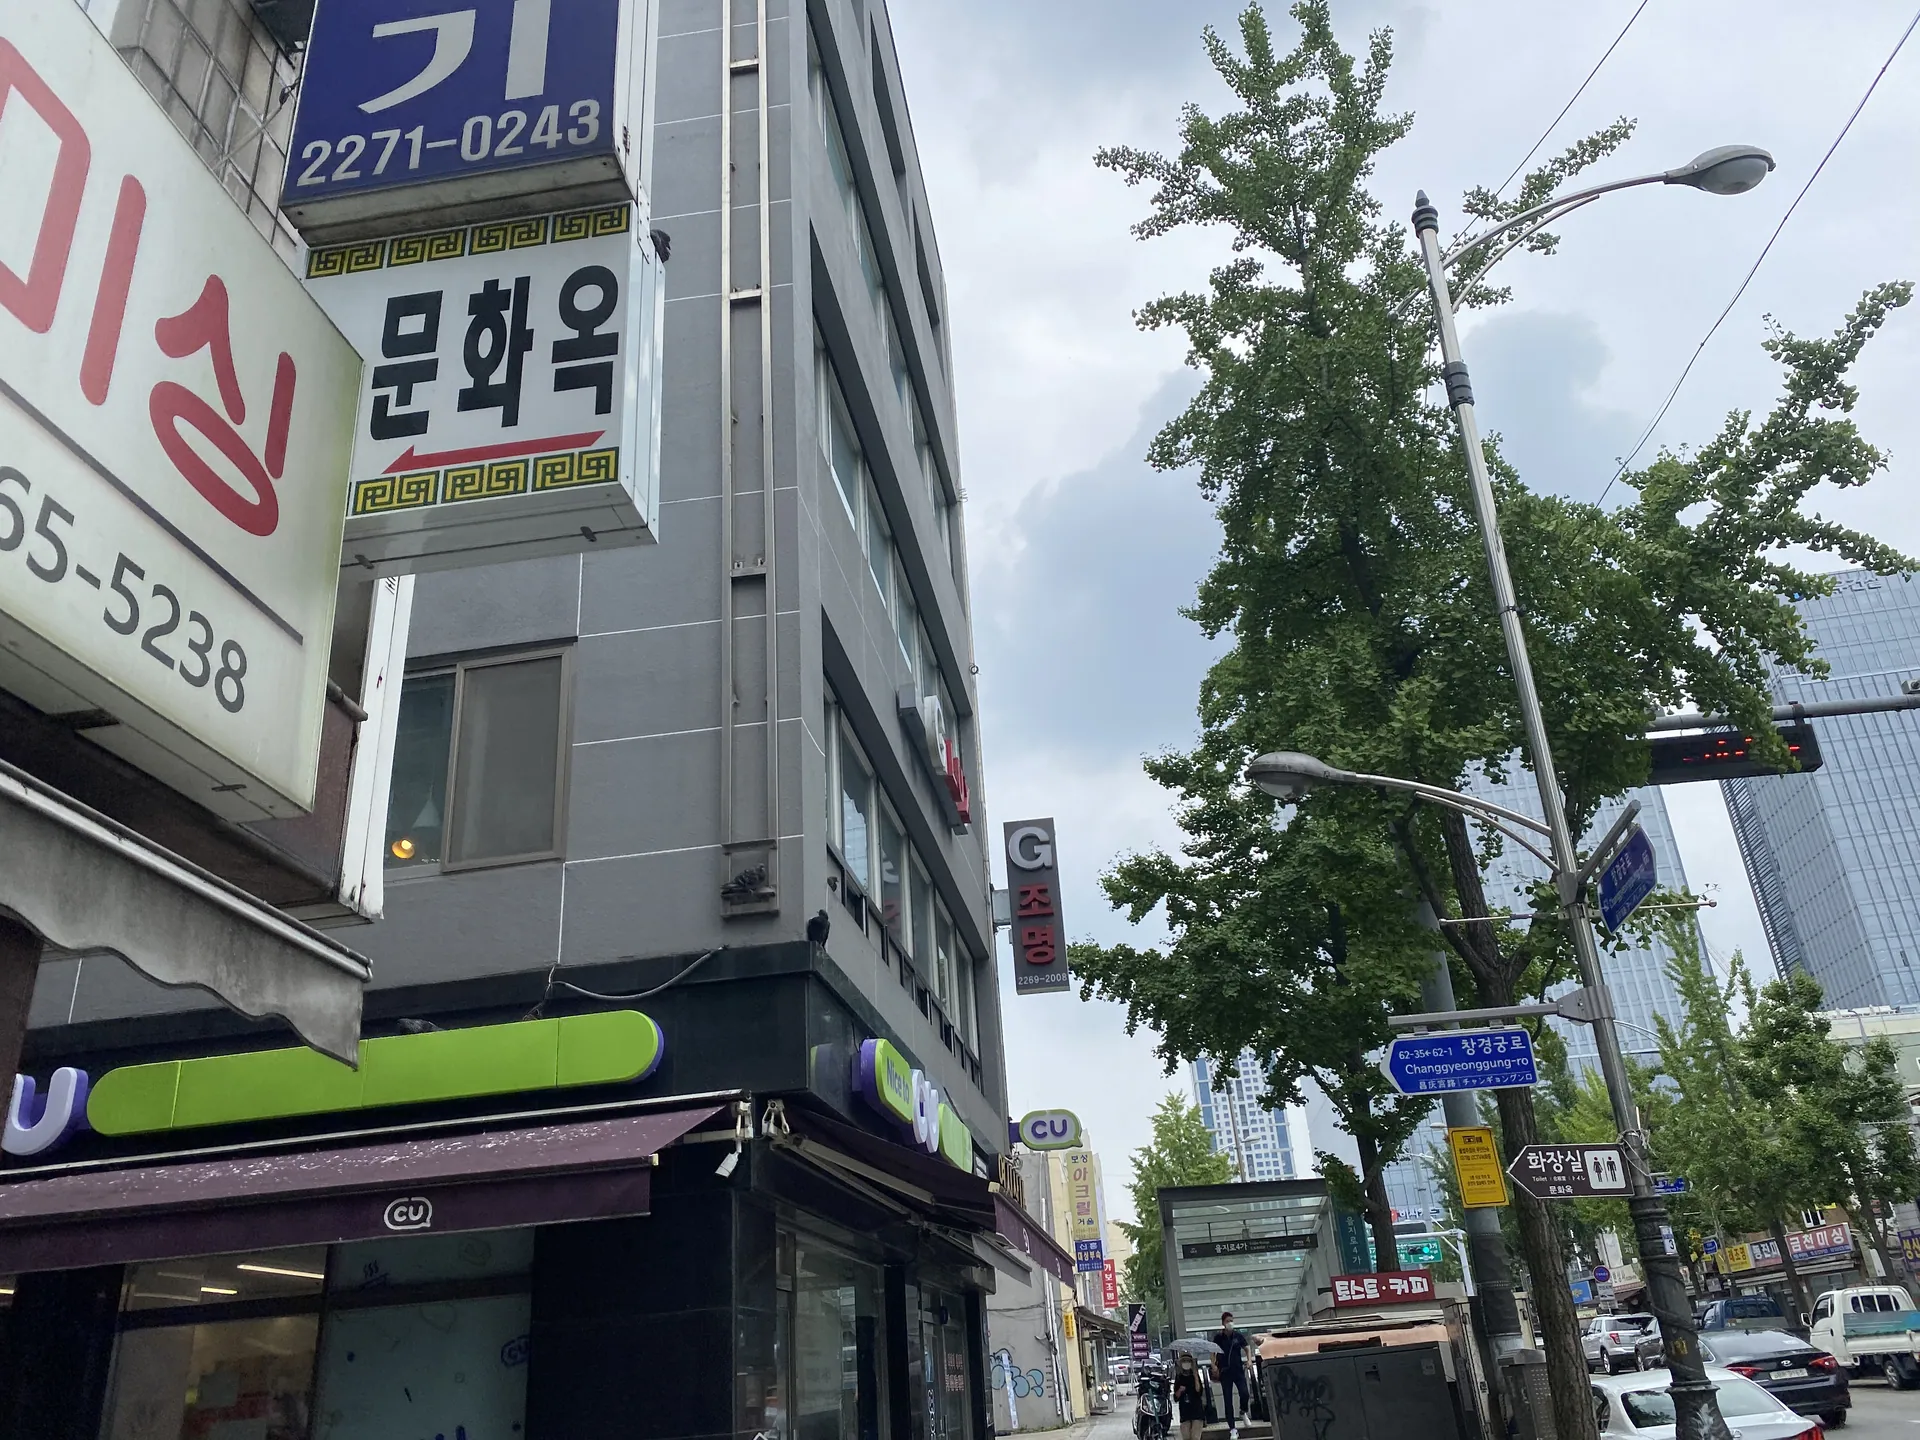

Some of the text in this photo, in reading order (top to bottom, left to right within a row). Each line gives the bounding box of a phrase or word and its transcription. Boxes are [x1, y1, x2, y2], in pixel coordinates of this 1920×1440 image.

[297, 98, 600, 186] 2271-0243
[0, 36, 296, 536] 미싱
[369, 265, 620, 440] 문화옥
[1008, 826, 1056, 966] G 조명
[1018, 973, 1067, 986] 2269-2008
[1432, 1047, 1453, 1057] 62-1
[1461, 1035, 1527, 1056] 창경궁로
[1405, 1056, 1529, 1075] Changgyeonggung-ro
[1031, 1118, 1068, 1139] CU
[1526, 1150, 1584, 1174] 화장실
[1073, 1167, 1091, 1216] 아크릴
[1346, 1216, 1362, 1265] 을지로4가
[1789, 1228, 1845, 1252] 금천미싱
